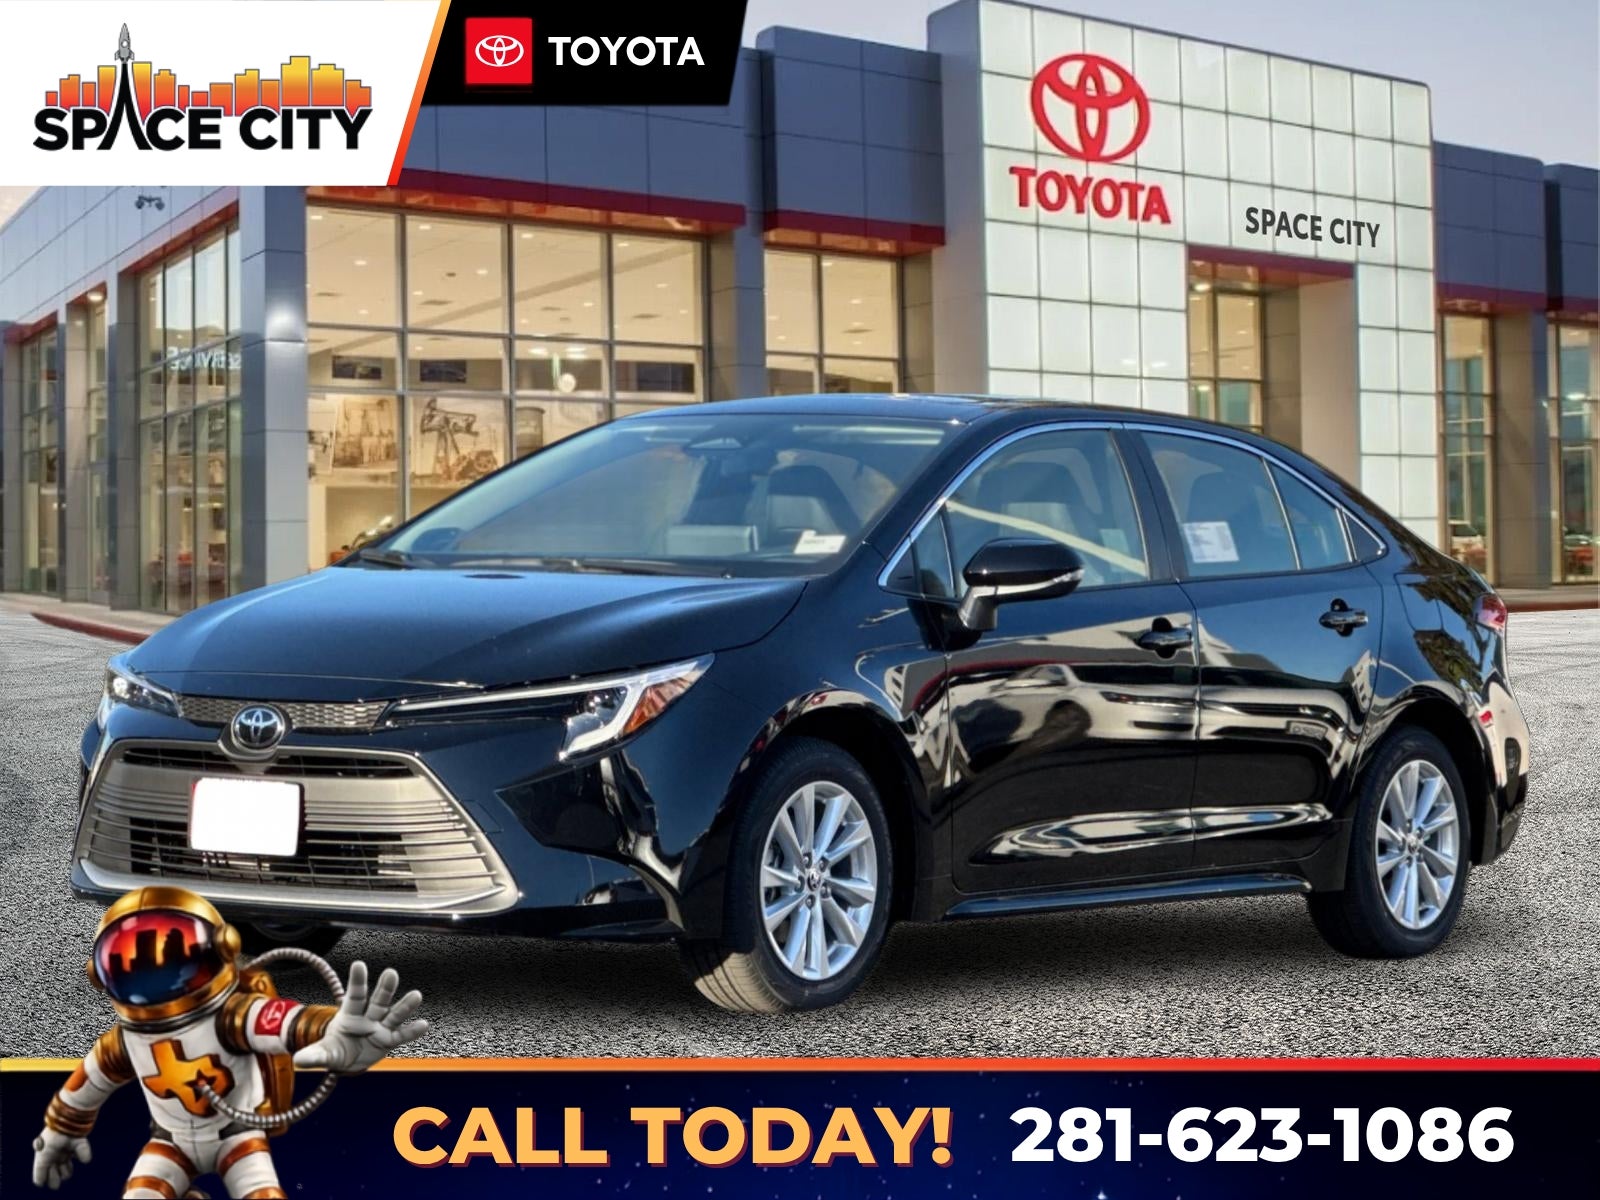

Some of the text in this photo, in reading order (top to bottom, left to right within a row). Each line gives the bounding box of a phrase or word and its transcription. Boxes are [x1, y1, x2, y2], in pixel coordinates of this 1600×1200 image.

[1009, 165, 1171, 225] TOYOTA
[1245, 206, 1381, 248] SPACE CITY
